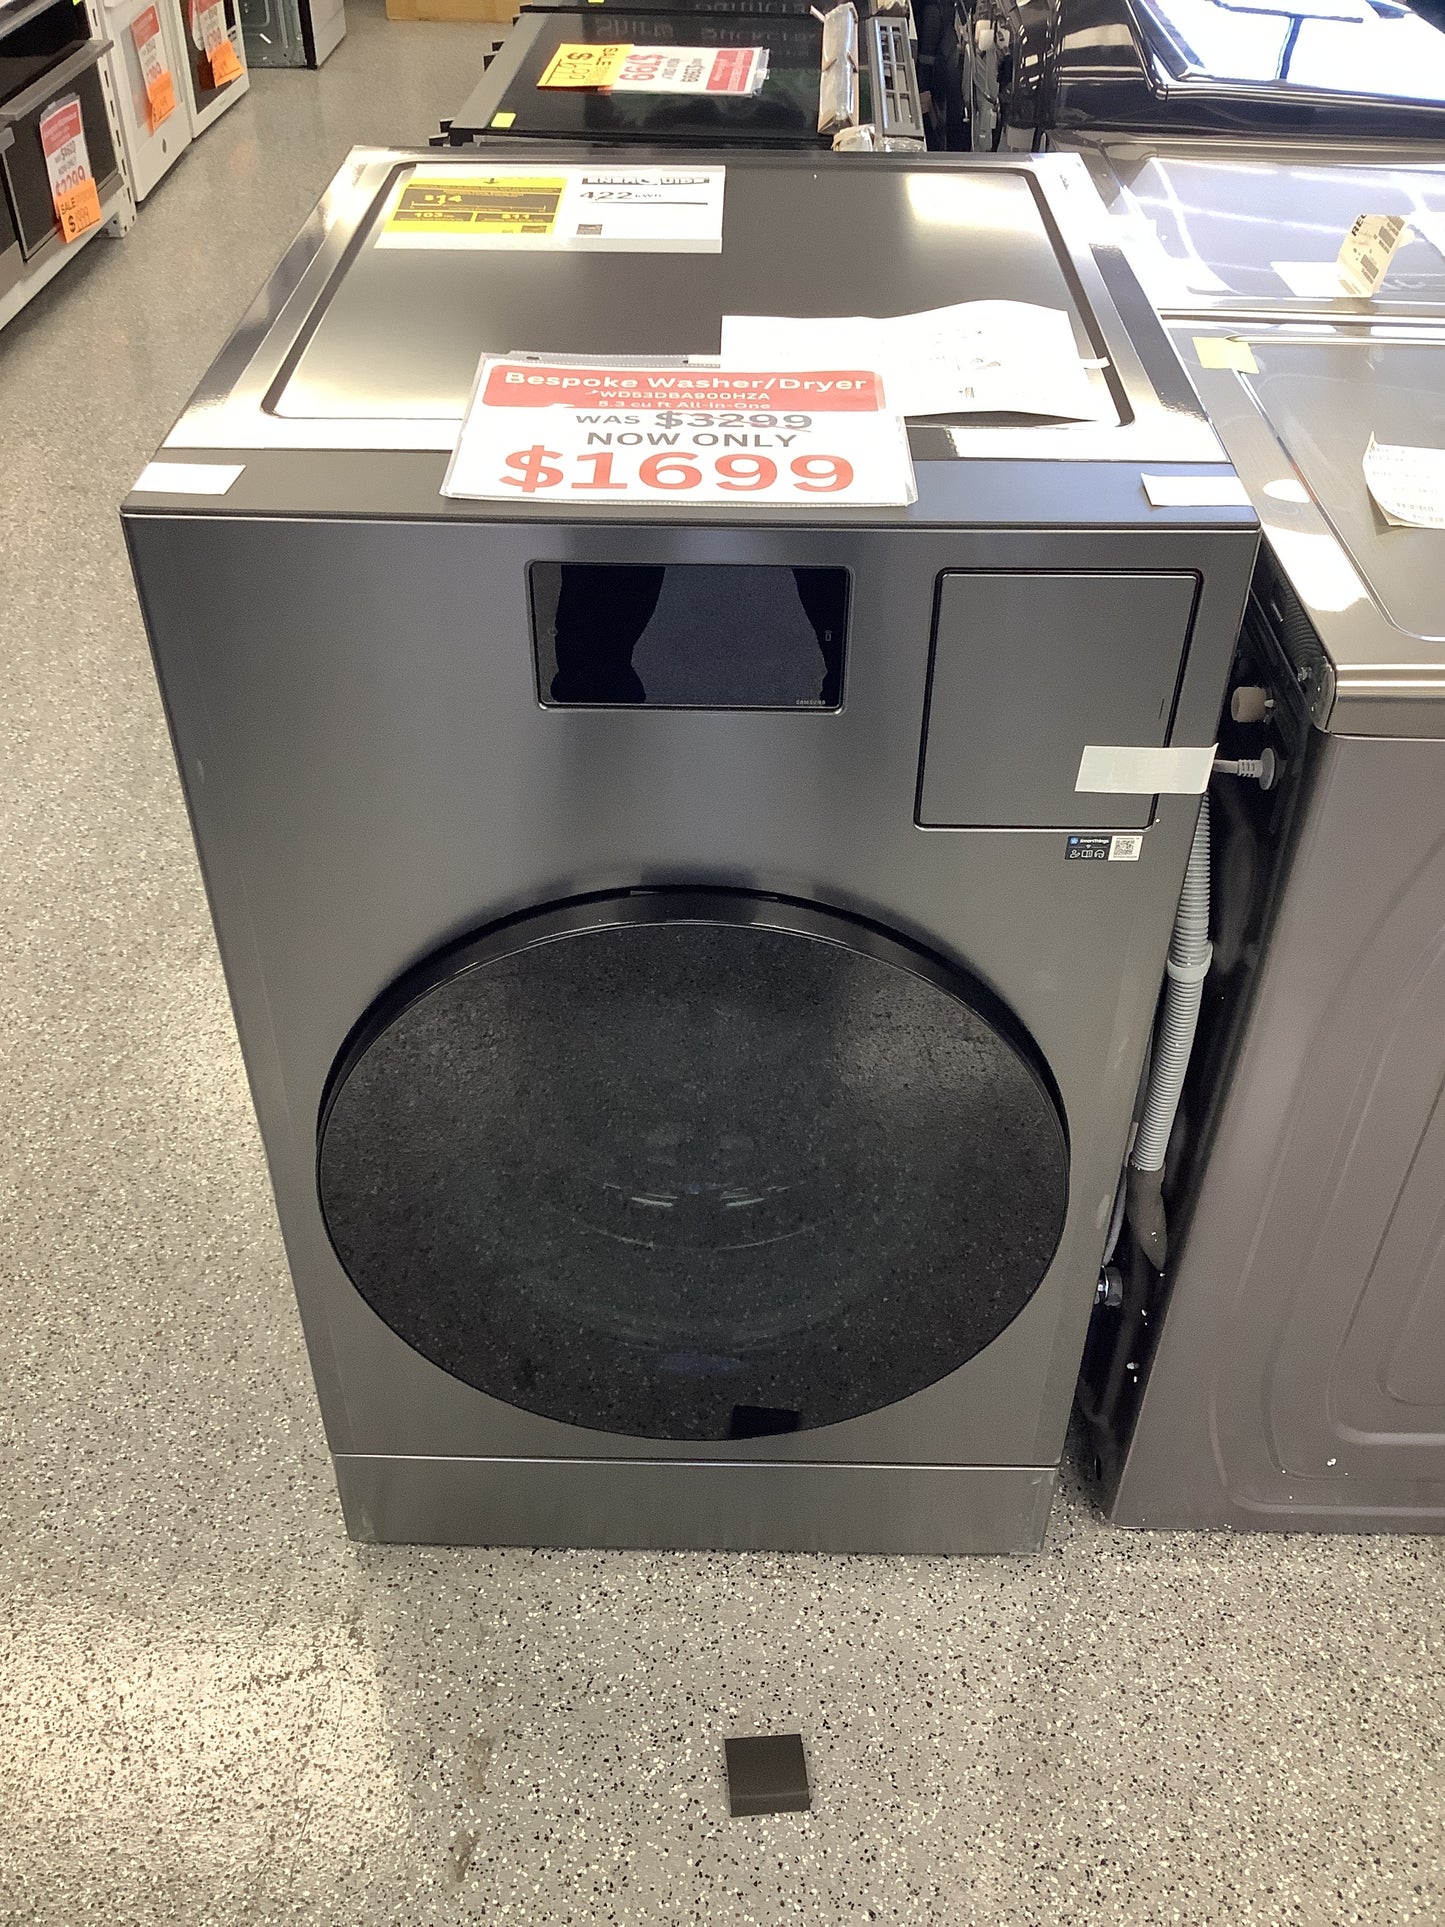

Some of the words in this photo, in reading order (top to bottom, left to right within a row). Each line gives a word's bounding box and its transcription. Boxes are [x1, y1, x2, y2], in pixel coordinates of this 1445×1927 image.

[595, 47, 619, 67] SALE
[619, 53, 669, 81] $799
[580, 191, 632, 200] 422
[60, 196, 77, 216] SALE
[505, 371, 638, 390] Bespoke
[647, 376, 867, 393] Washer/Dryer
[657, 400, 674, 409] ft
[575, 414, 641, 425] WAS
[655, 411, 813, 430] $3299
[586, 431, 684, 447] NOW
[692, 433, 798, 449] ONLY
[498, 444, 855, 494] $1699
